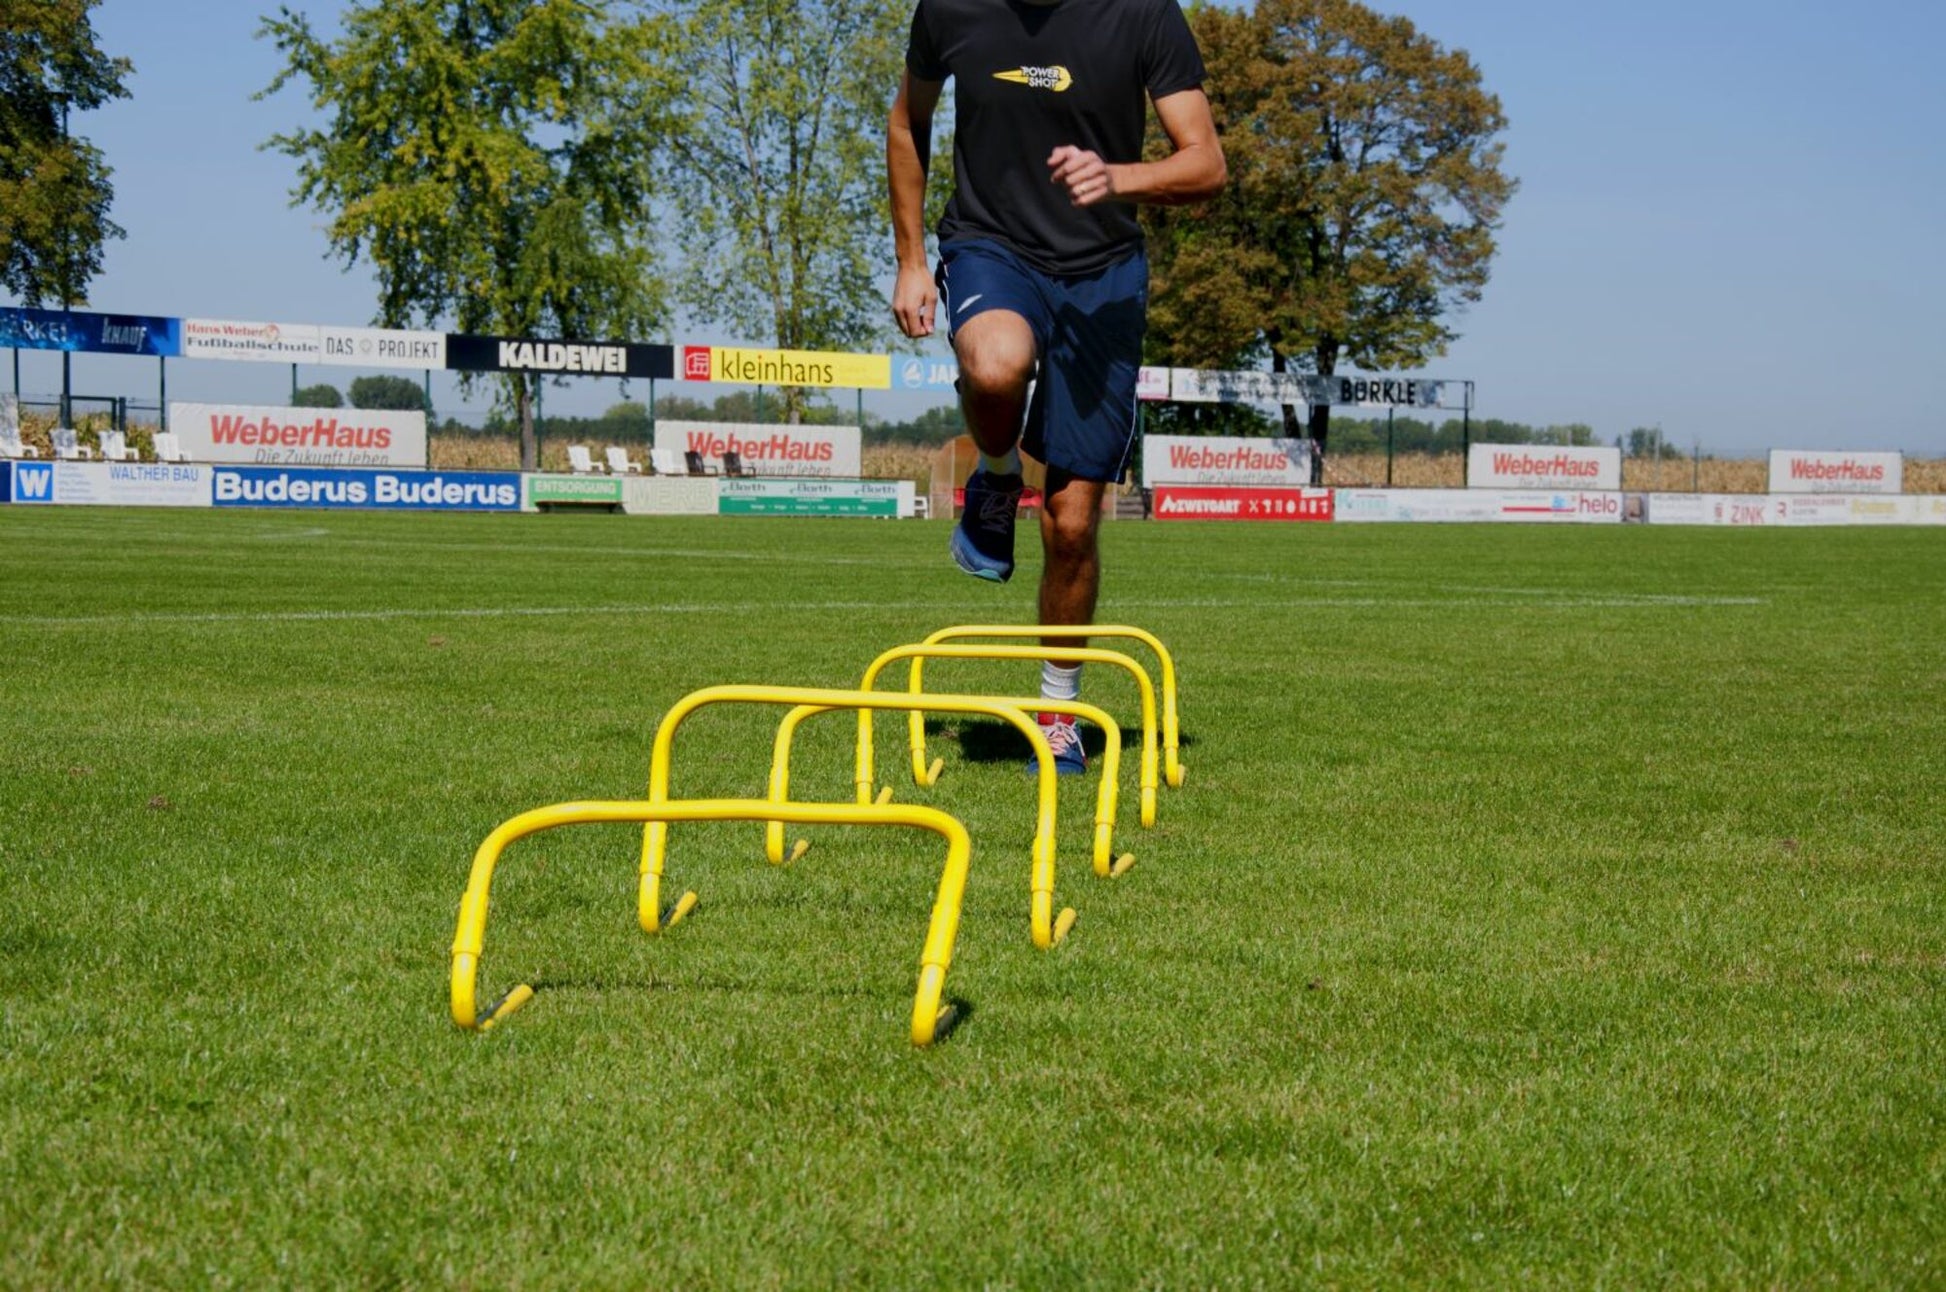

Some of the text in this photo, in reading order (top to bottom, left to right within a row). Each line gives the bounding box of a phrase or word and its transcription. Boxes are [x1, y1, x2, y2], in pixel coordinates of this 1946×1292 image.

[1020, 66, 1061, 79] POWER
[1028, 77, 1058, 88] SHOT
[102, 317, 147, 352] KNAUF
[326, 336, 438, 359] DAS PROJEKT
[499, 341, 627, 374] KALDEWEI
[720, 350, 834, 384] kleinhans
[210, 414, 392, 449] WeberHaus
[254, 448, 281, 464] Die
[284, 449, 345, 465] Zukunft
[687, 431, 833, 462] WeberHaus
[1170, 445, 1288, 471] WeberHaus
[109, 466, 199, 482] WALTHER BAU
[1493, 453, 1600, 477] WeberHaus
[1790, 458, 1884, 480] WeberHaus
[18, 469, 51, 498] W
[215, 472, 517, 505] Buderus Buderus
[1579, 492, 1619, 514] helo
[1730, 505, 1766, 525] ZINK
